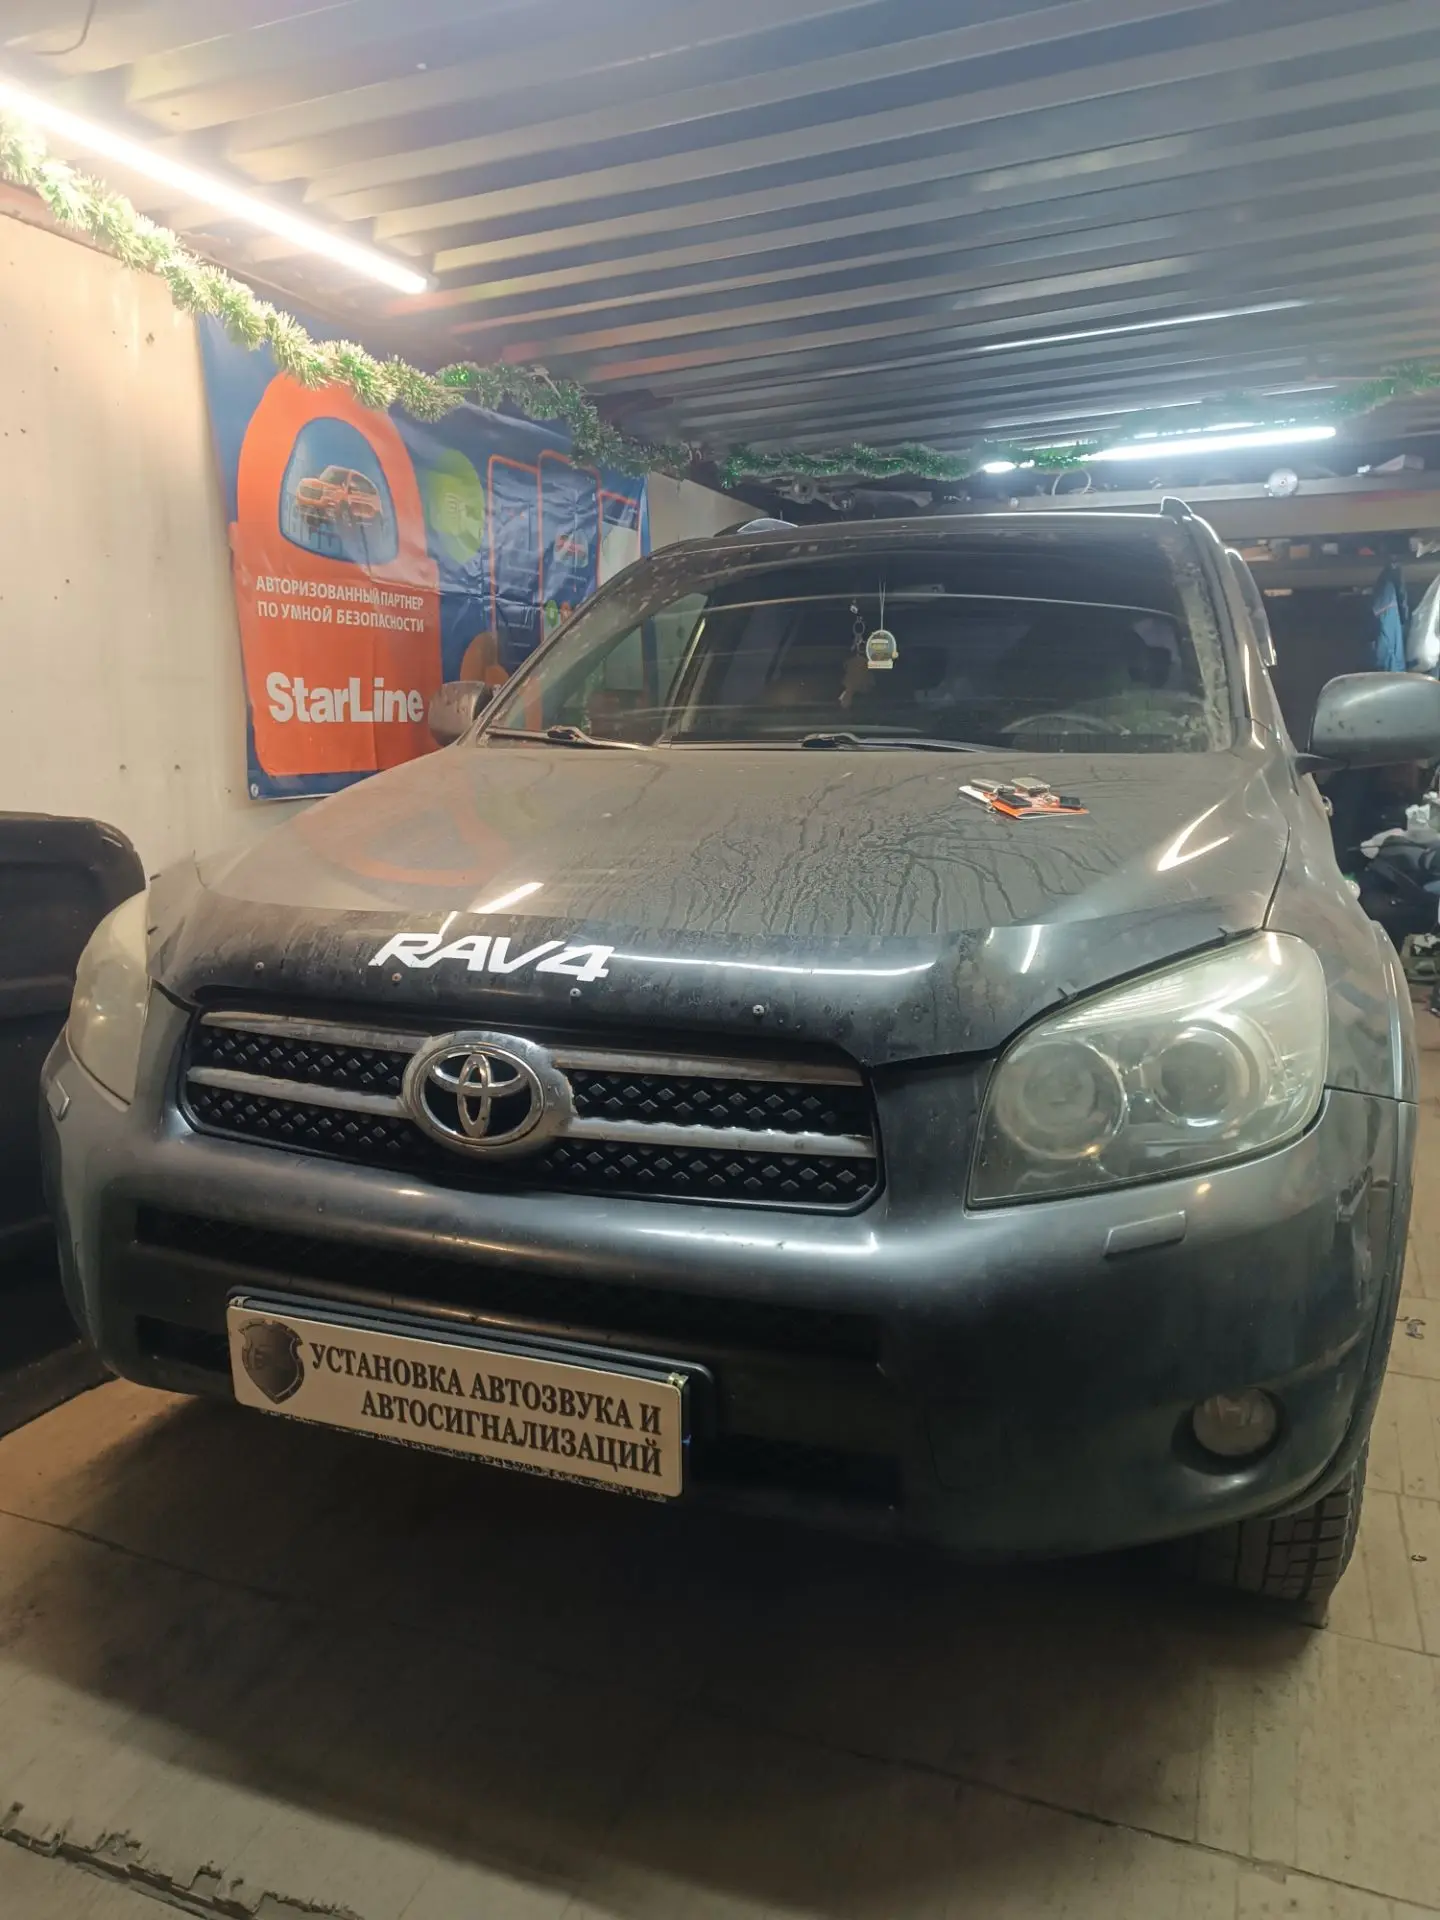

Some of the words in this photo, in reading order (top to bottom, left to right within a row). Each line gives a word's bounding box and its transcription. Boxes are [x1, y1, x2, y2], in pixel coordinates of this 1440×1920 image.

[256, 575, 381, 605] АВТОРИЗОВАННЫЙ
[381, 592, 424, 610] ПАРТНЕР
[257, 600, 279, 618] ПО
[281, 603, 333, 623] УМНОЙ
[336, 609, 424, 632] БЕЗОПАСНОСТИ
[266, 671, 425, 723] StarLine
[368, 932, 615, 982] RAV4
[310, 1342, 464, 1396] УСТАНОВКА
[471, 1372, 633, 1429] АВТОЗВУКА
[640, 1402, 662, 1435] И
[361, 1390, 663, 1476] АВТОСИГНАЛИЗАЦИЙ
